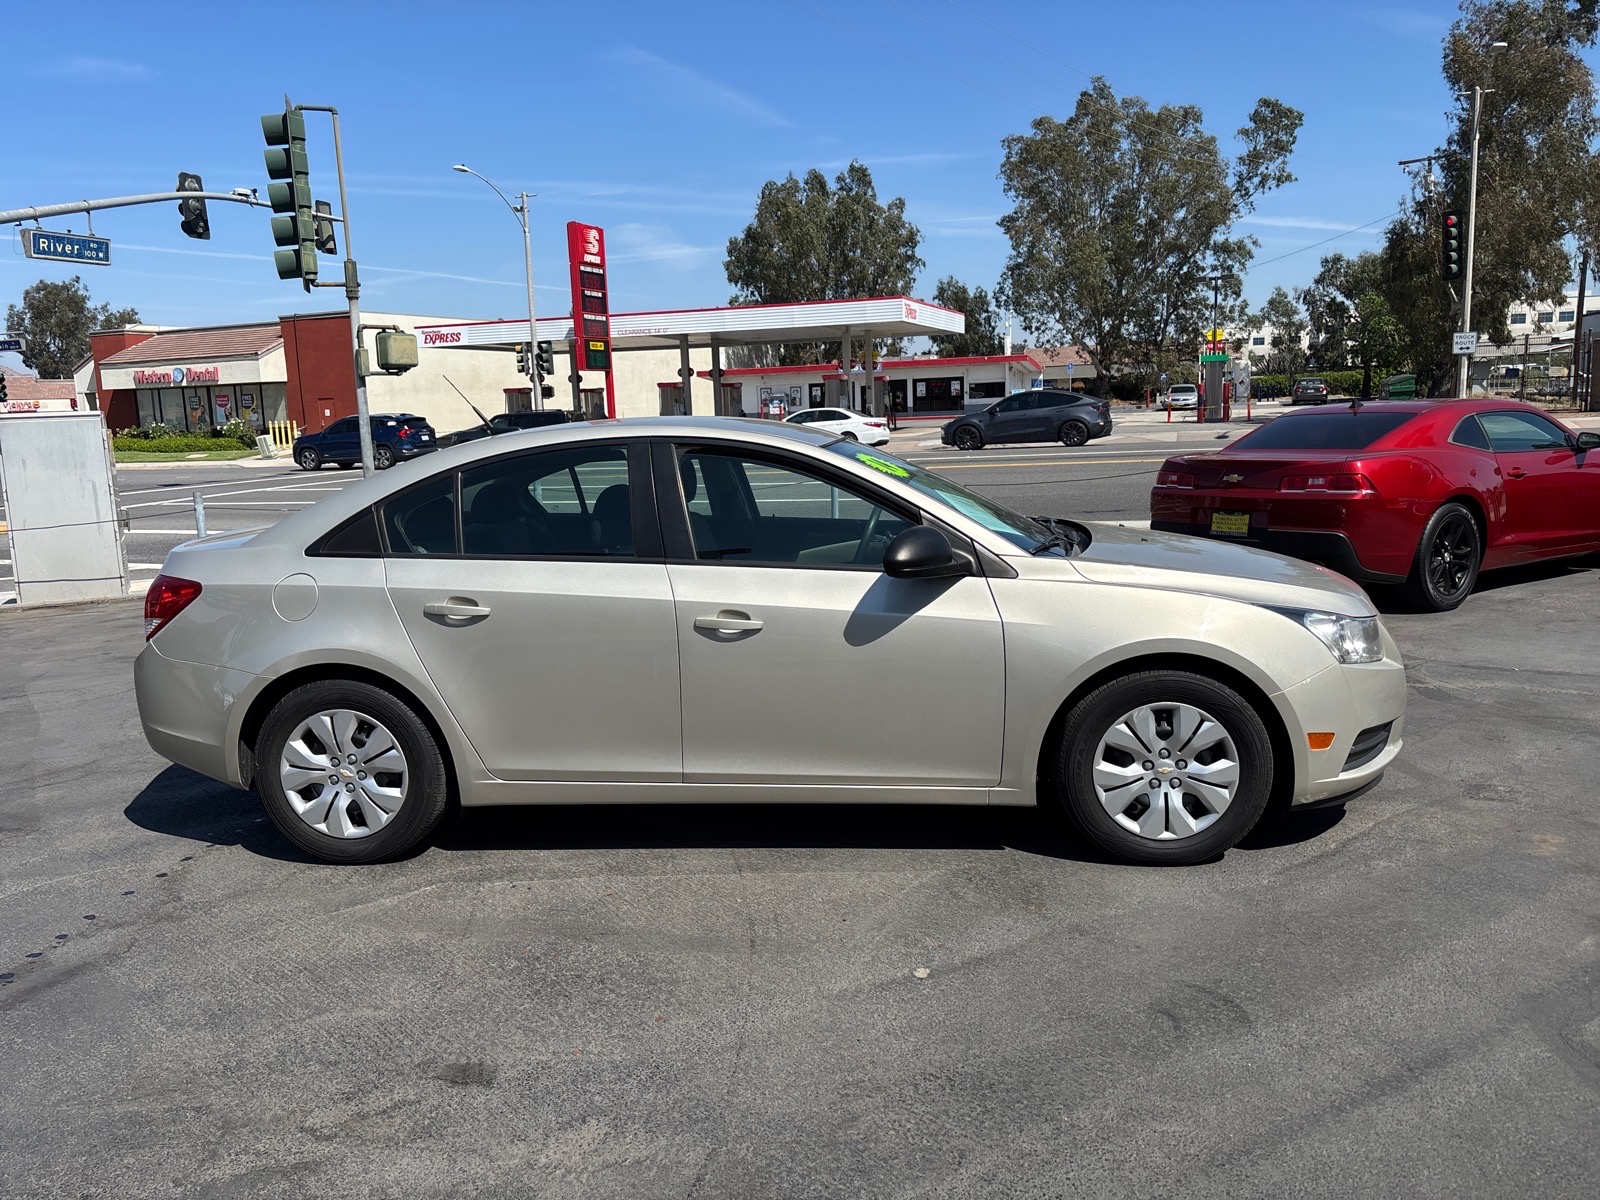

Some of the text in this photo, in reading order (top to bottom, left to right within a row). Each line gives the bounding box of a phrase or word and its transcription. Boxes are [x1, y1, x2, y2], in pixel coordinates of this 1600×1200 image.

[39, 238, 80, 254] River
[584, 254, 601, 264] EXPRESS
[424, 332, 461, 345] EXPRESS
[617, 328, 652, 336] CLEARANCE
[133, 367, 220, 384] Western Dental
